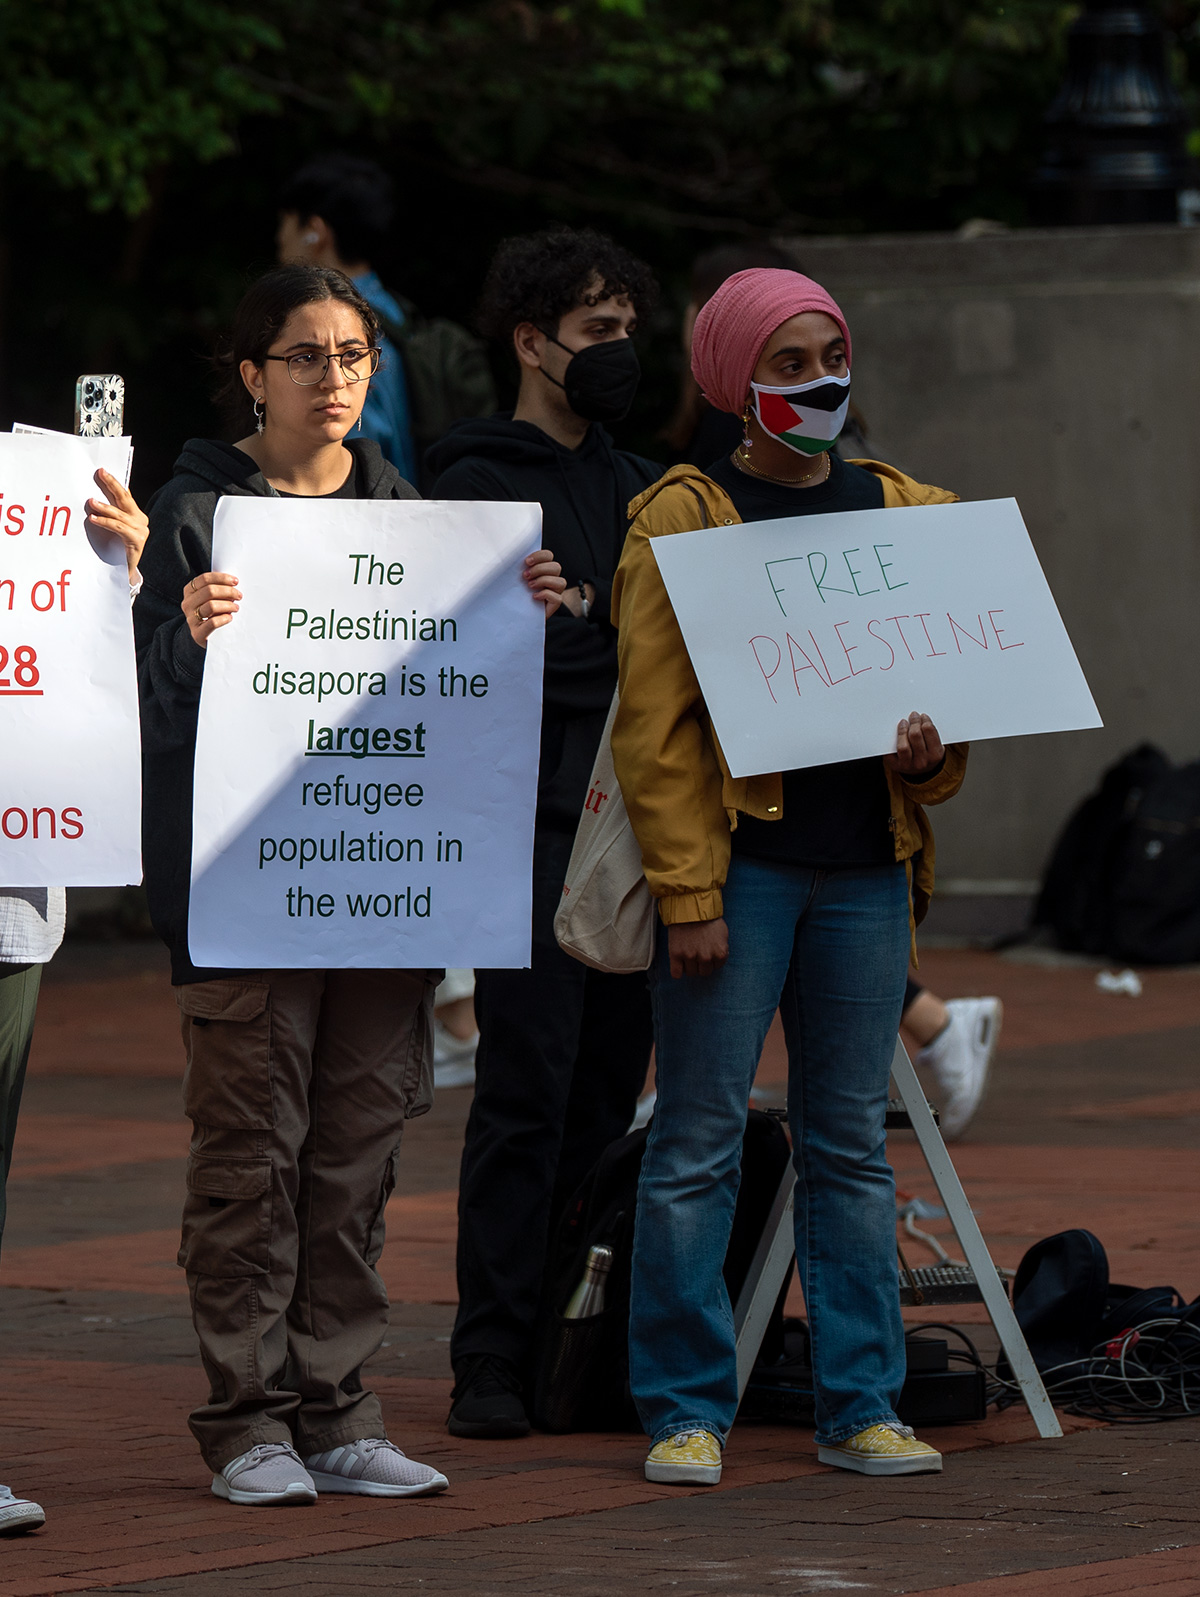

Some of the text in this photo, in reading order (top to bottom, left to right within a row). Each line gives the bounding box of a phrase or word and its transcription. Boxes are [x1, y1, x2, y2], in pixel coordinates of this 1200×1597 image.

[38, 494, 72, 537] in
[348, 553, 406, 586] The
[764, 543, 910, 618] FREE
[30, 568, 72, 613] of
[285, 607, 459, 642] Palestinian
[748, 608, 1025, 704] PALESTINE
[252, 664, 489, 703] disapora is the
[304, 719, 427, 760] largest
[302, 774, 425, 815] refugee
[258, 830, 463, 870] population in
[285, 885, 432, 918] the world
